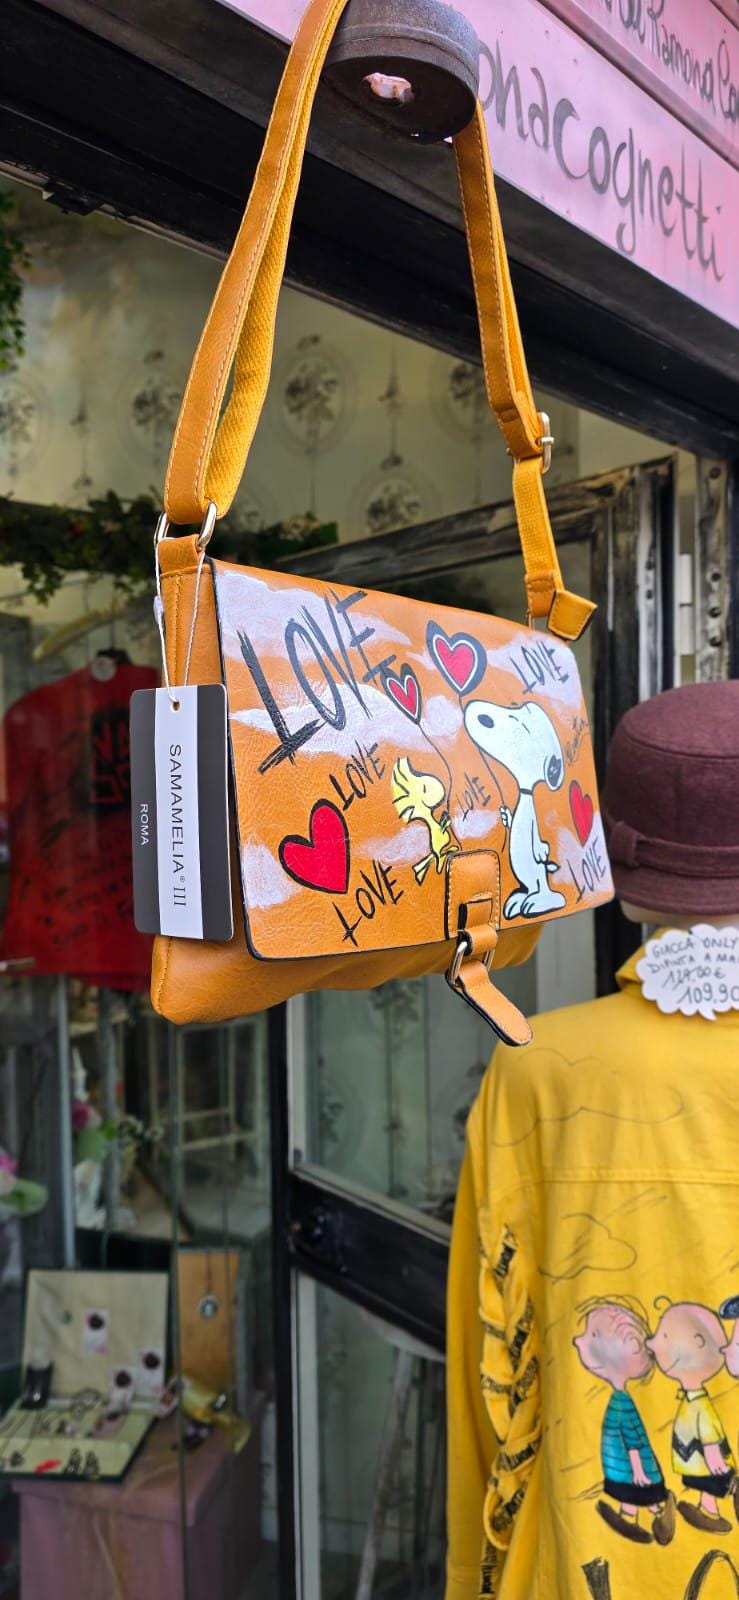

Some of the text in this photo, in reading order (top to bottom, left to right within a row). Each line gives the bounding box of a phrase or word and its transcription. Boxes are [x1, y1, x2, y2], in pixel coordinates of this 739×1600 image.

[647, 0, 716, 116] Ramona
[236, 586, 397, 775] LOVE
[509, 639, 570, 694] LOVE
[329, 740, 386, 811] LOVE
[456, 771, 492, 822] LOVE
[140, 803, 150, 846] ROMA
[173, 887, 187, 907] III
[565, 835, 607, 904] LOVE
[332, 859, 405, 947] LOVE
[702, 936, 739, 950] ONLY
[704, 952, 712, 963] A
[716, 953, 739, 964] MA
